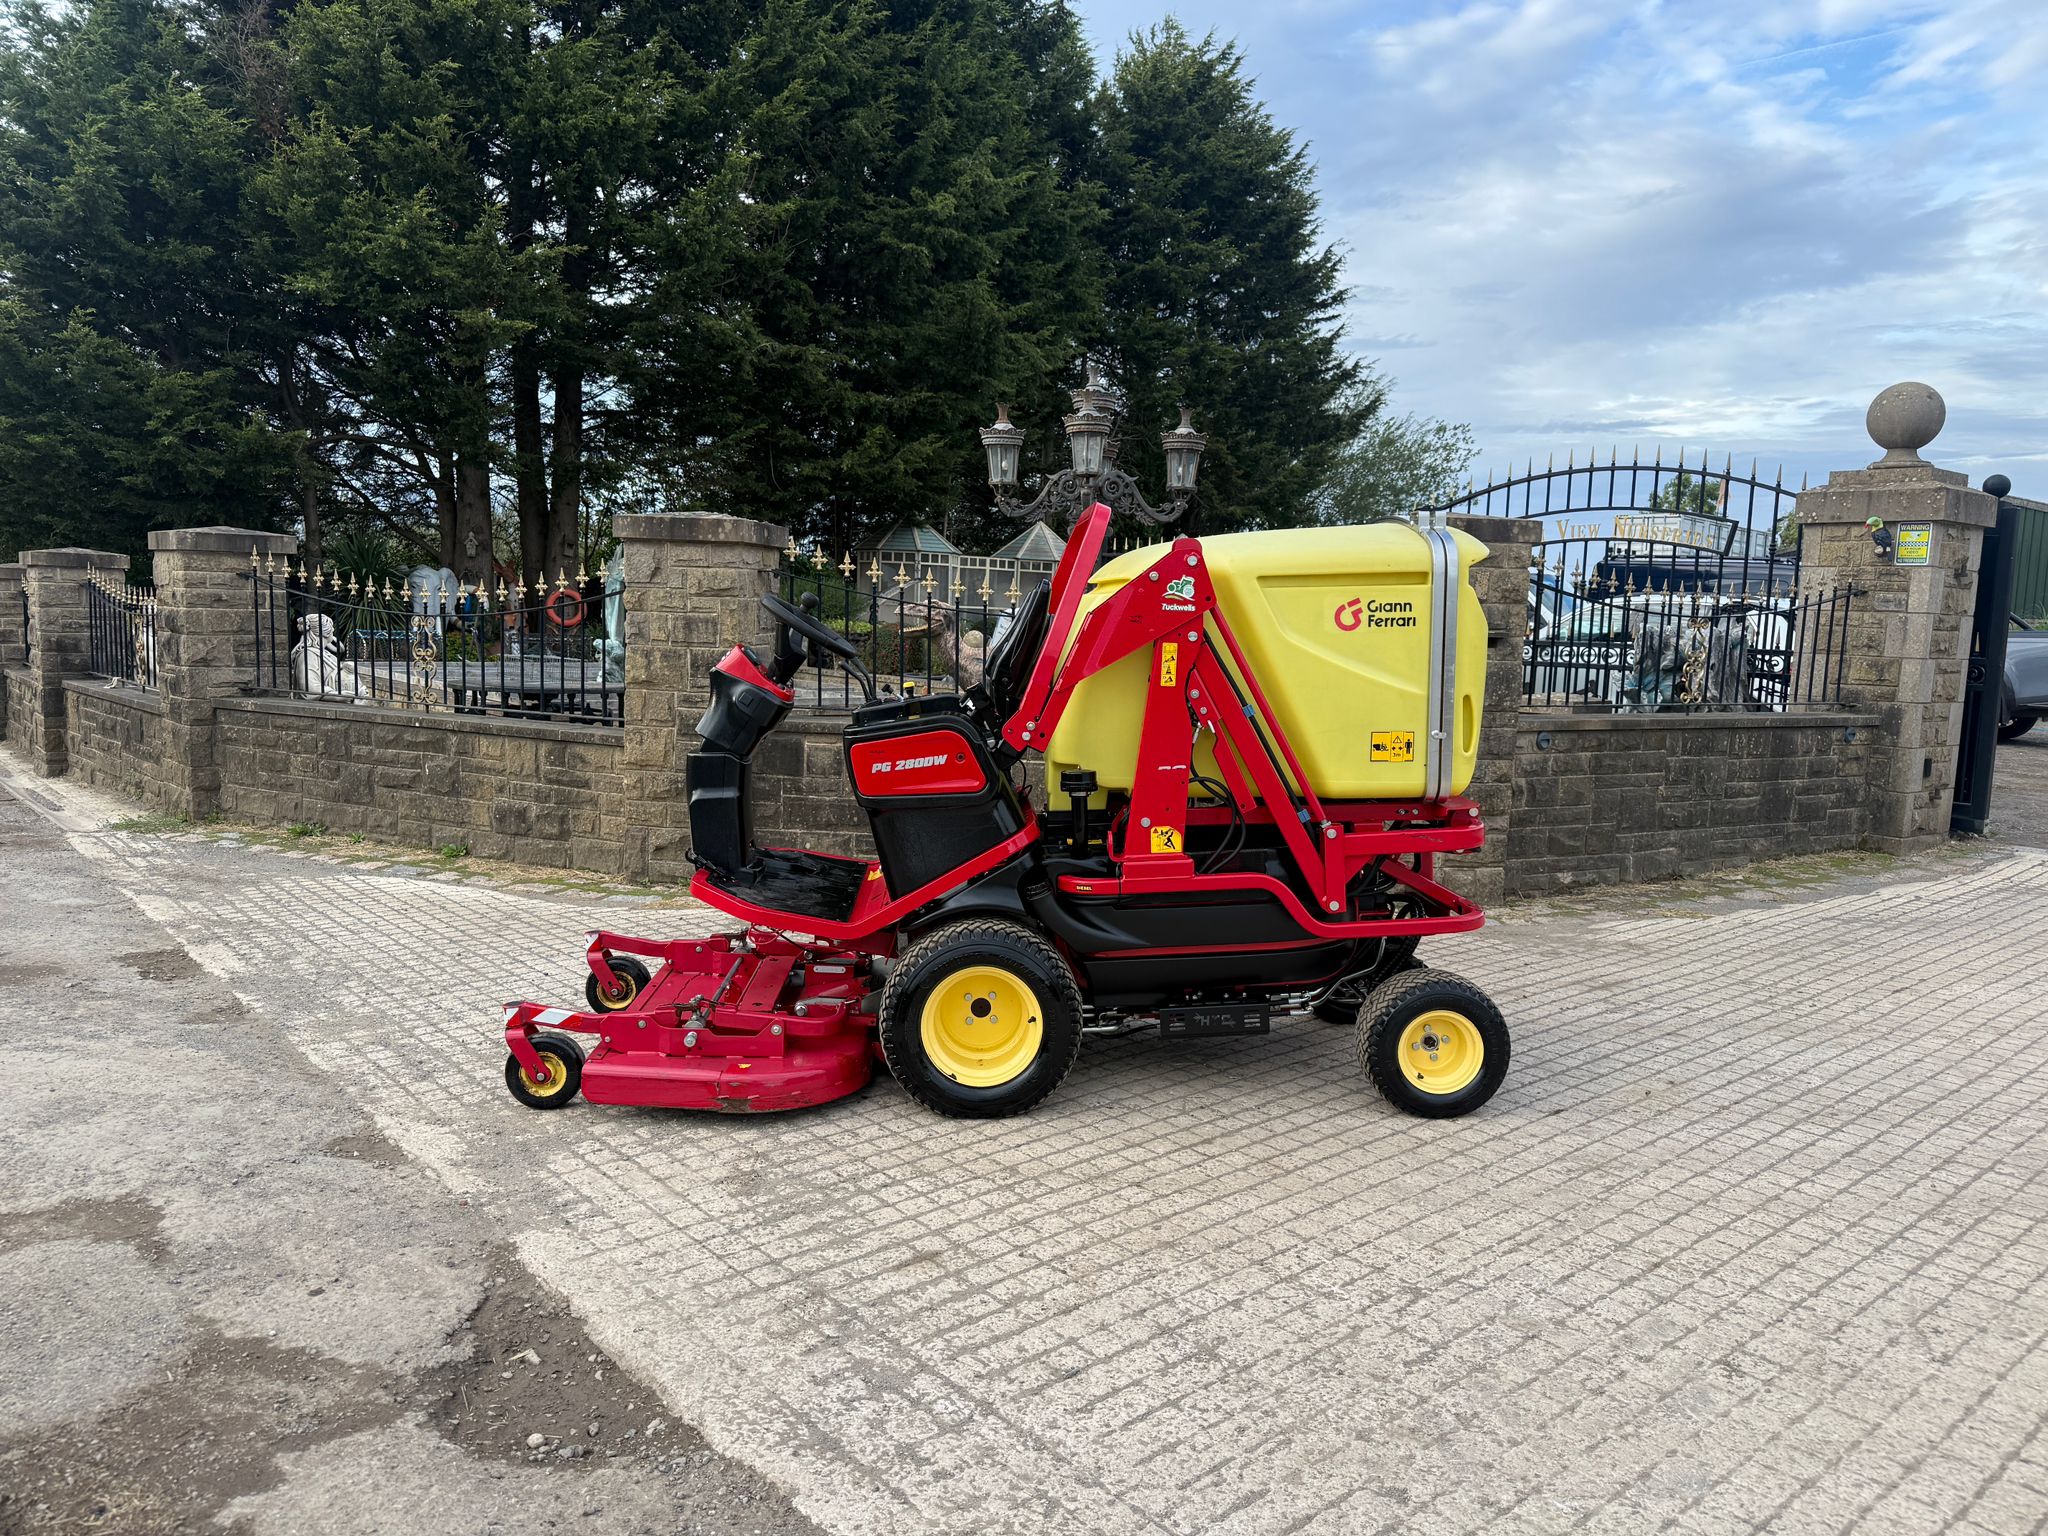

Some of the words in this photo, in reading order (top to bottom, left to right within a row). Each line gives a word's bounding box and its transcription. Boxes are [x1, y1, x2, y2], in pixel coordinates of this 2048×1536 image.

[1161, 602, 1196, 612] Tuckwells
[1368, 614, 1416, 628] Ferrari
[871, 761, 893, 774] PG
